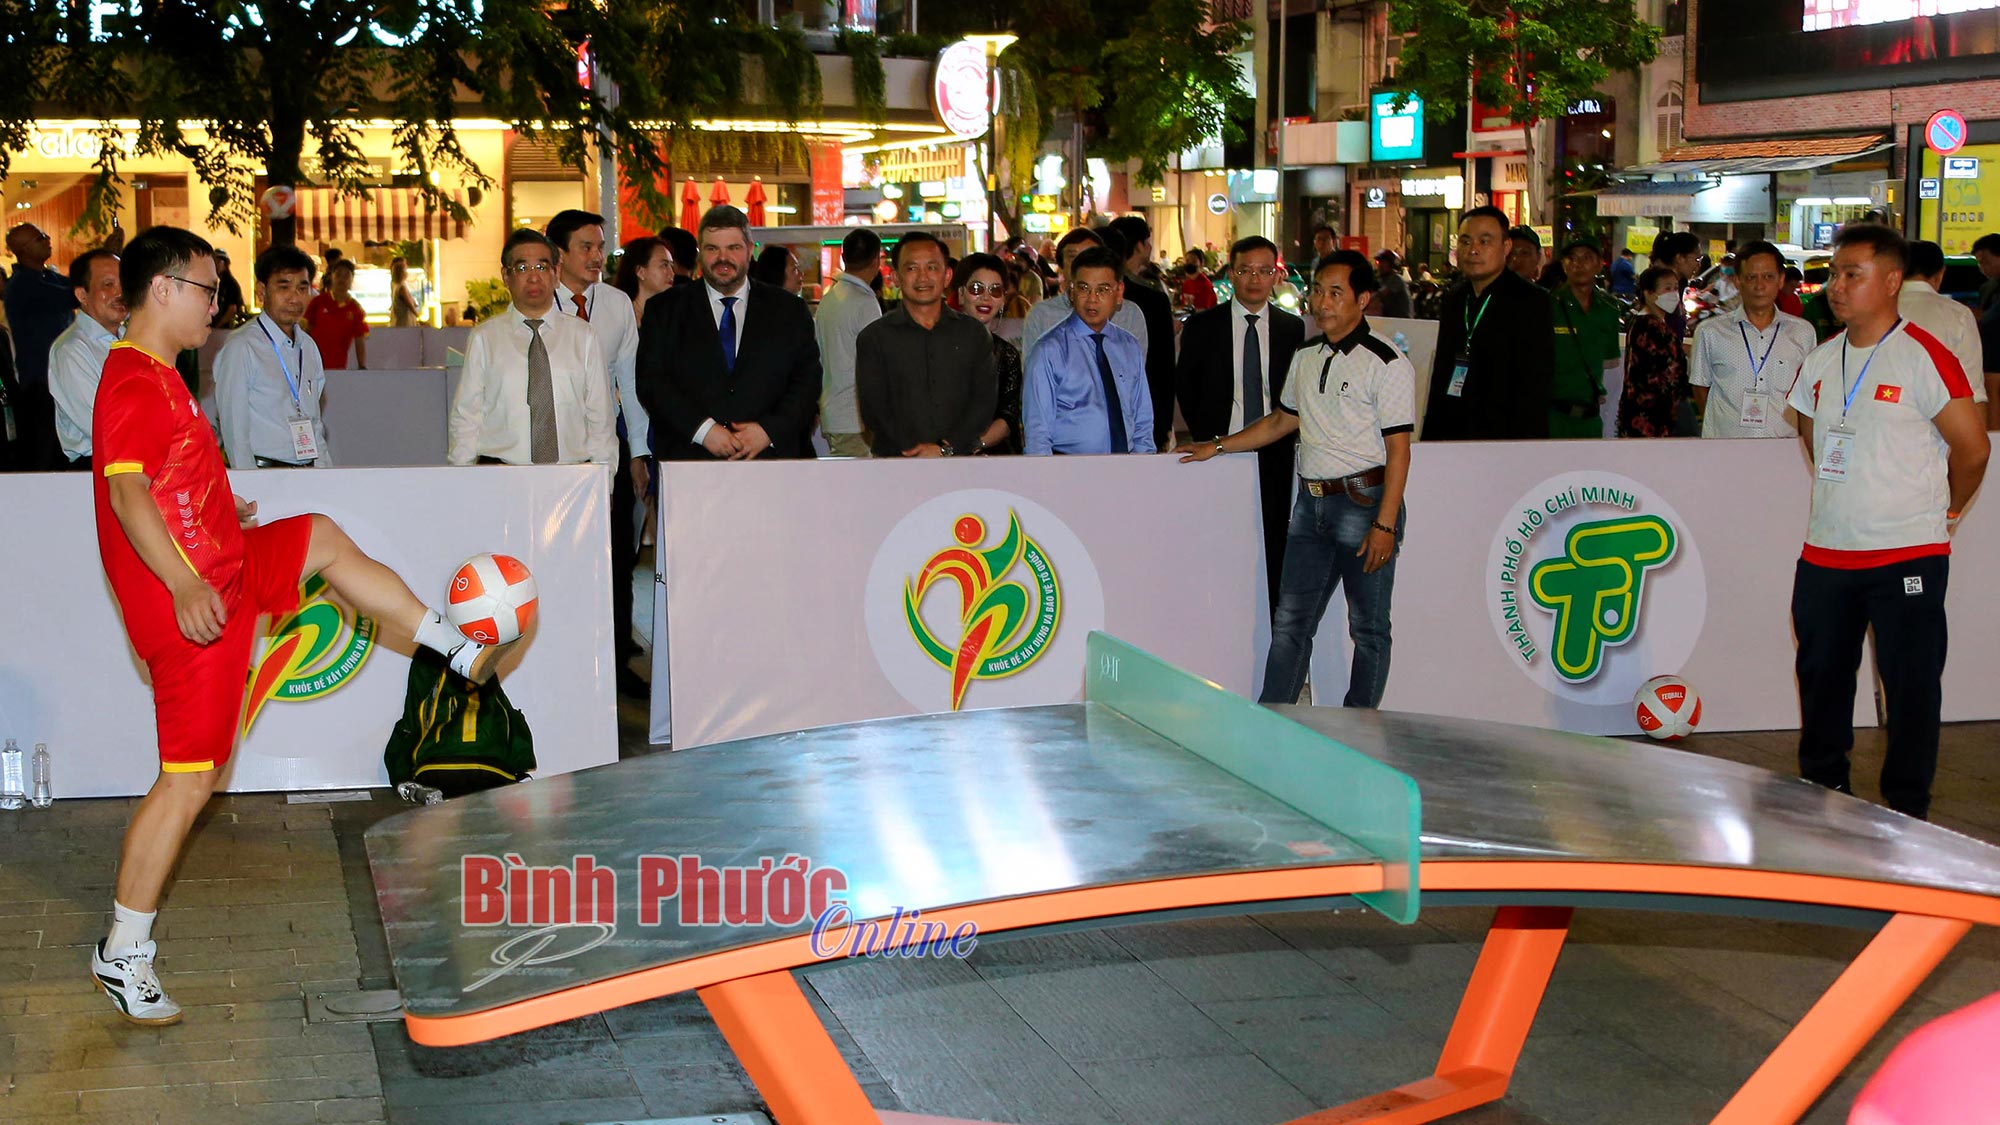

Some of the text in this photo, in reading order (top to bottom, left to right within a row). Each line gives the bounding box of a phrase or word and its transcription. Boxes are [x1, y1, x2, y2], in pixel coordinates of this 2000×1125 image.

[1501, 486, 1635, 662] THÀNH PHỐ HỒ CHÍ MINH
[289, 681, 312, 694] KHỎE
[325, 669, 342, 685] XÂY
[341, 650, 361, 673] DỰNG
[355, 639, 368, 651] VÀ
[988, 659, 1010, 672] KHỎE
[1020, 644, 1035, 660] XÂY
[1033, 625, 1050, 647] DỰNG
